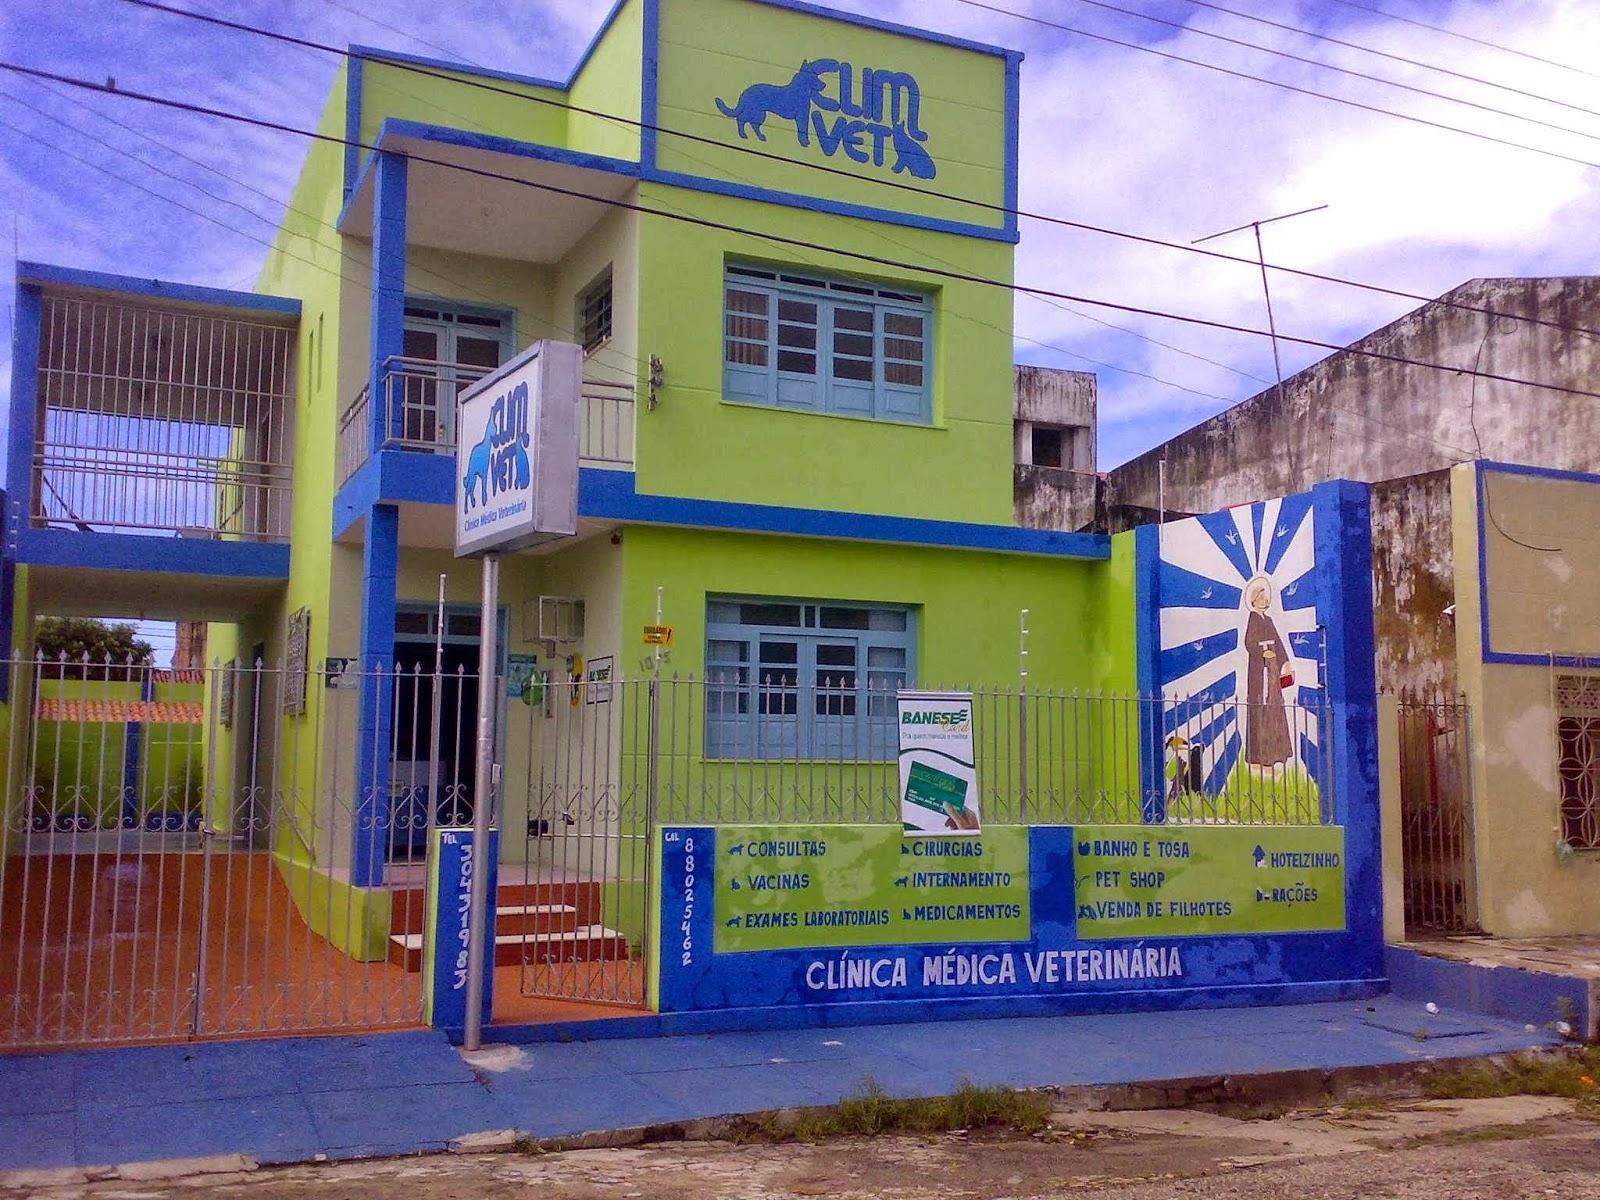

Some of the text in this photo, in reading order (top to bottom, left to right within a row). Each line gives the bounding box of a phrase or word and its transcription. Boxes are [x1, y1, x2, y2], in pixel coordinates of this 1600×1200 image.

[811, 110, 892, 168] VET
[490, 443, 518, 498] VET
[902, 709, 968, 725] BANESE
[441, 832, 458, 845] TEL
[747, 841, 826, 858] CONSULTAS
[912, 841, 983, 858] CIRURGIAS
[1094, 840, 1190, 858] BANHO E TOSA
[1271, 852, 1341, 868] HOTELZINHO
[747, 873, 810, 890] VACINAS
[912, 871, 1011, 888] INTERNAMENTO
[1095, 871, 1165, 888] PET SHOP
[1272, 881, 1318, 908] RAÇÕES
[914, 904, 1021, 921] MEDICAMENTOS
[1097, 901, 1232, 918] VENDA DE FILHOTES
[745, 909, 890, 928] EXAMES LABORATORIAIS
[806, 941, 1183, 990] CLÍNICA MÉDICA VETERINÁRIA
